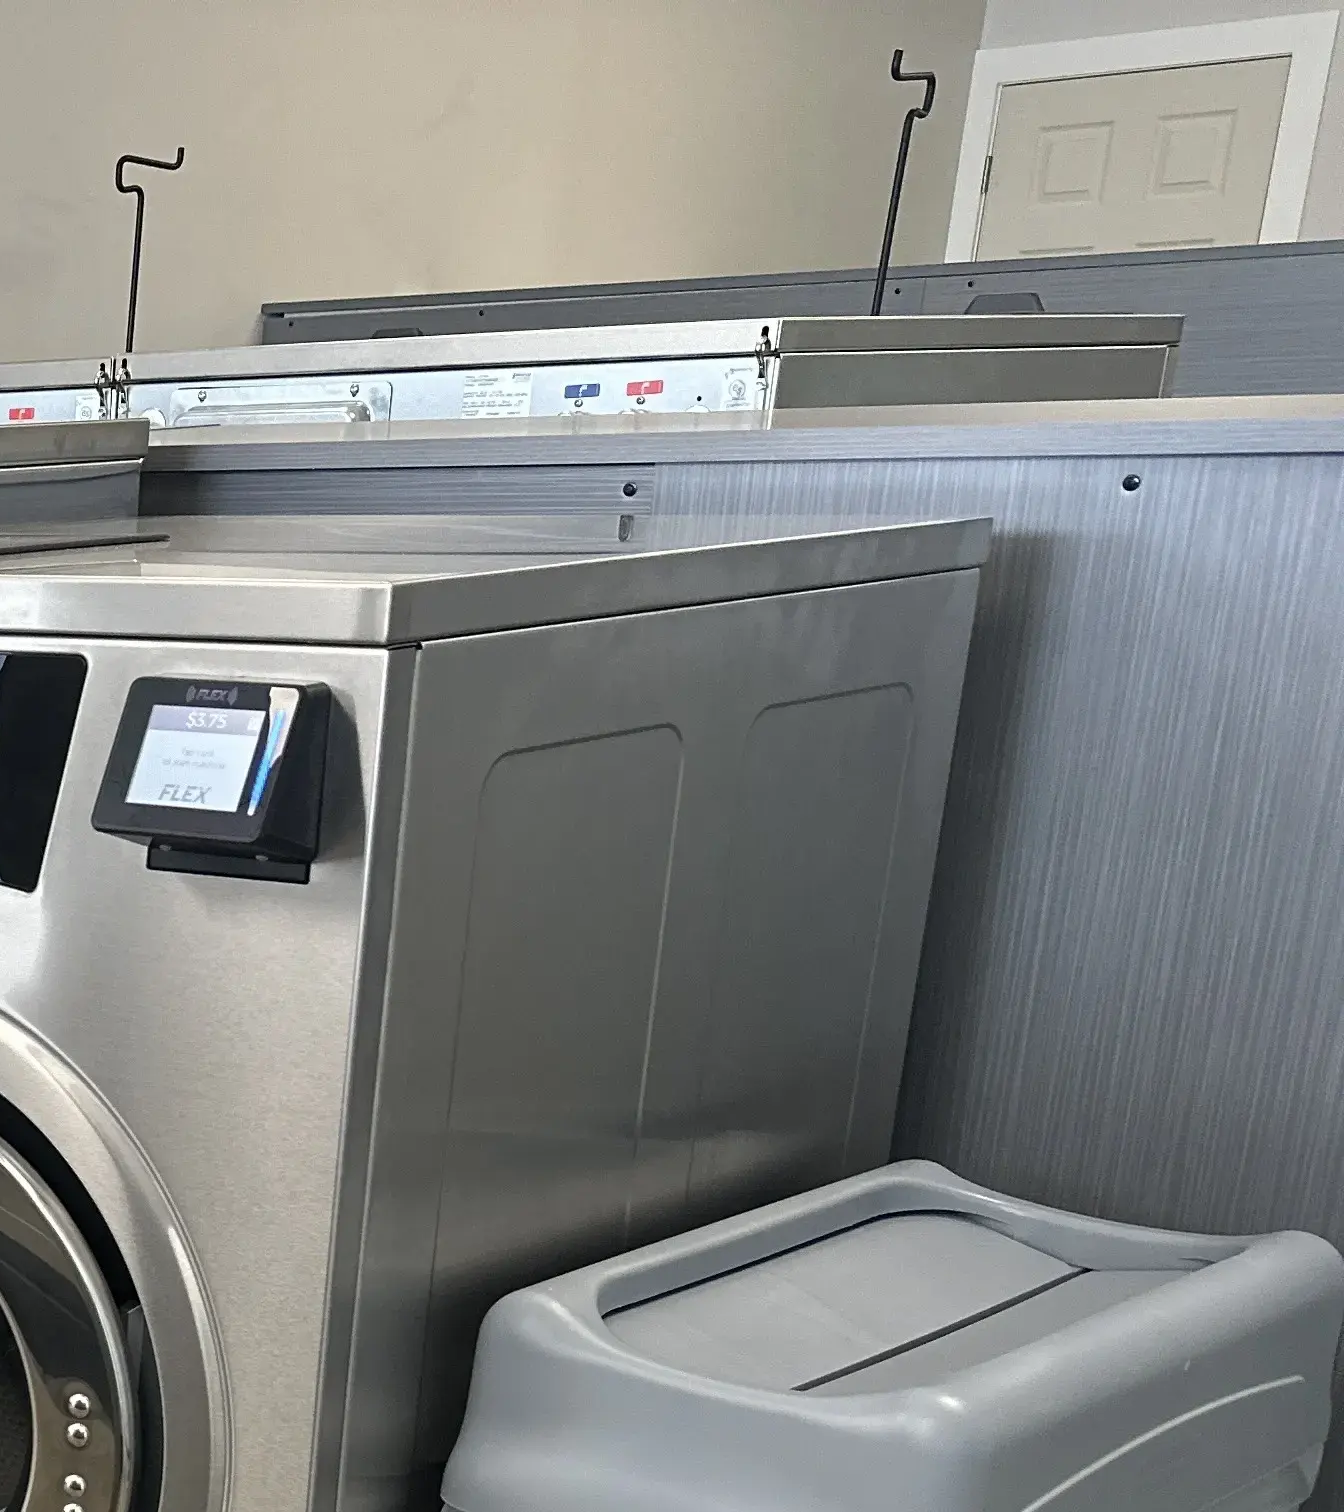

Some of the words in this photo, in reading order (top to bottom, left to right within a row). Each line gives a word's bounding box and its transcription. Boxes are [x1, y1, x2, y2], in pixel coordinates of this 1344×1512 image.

[195, 688, 229, 701] FLEX
[185, 710, 229, 729] $3.75
[157, 783, 212, 804] FLEX
